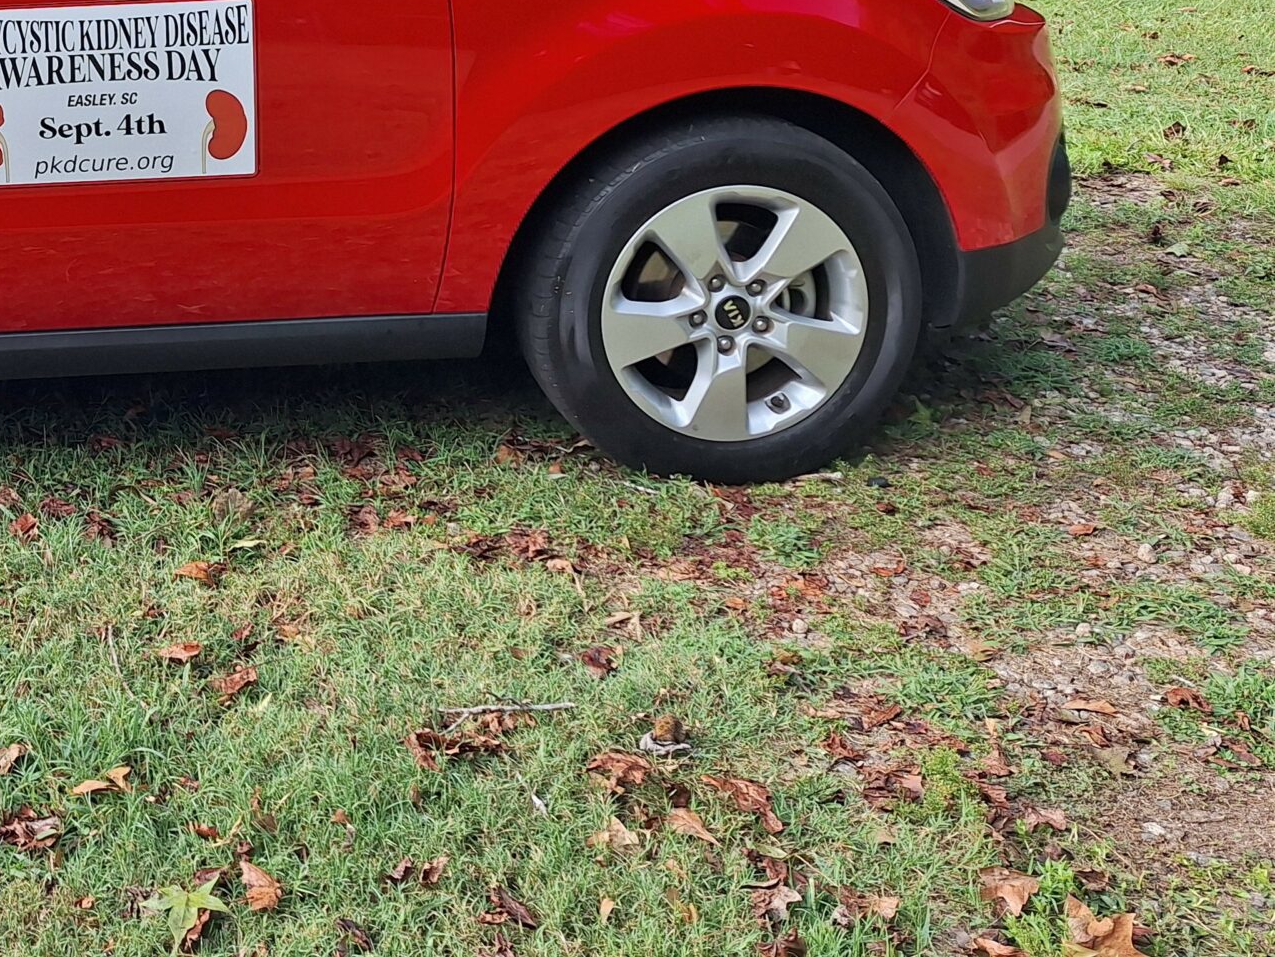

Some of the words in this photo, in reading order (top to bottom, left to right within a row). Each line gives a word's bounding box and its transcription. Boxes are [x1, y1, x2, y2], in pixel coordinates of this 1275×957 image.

[79, 16, 159, 51] KIDNEY
[165, 4, 249, 48] DISEASE
[167, 48, 222, 82] DAY
[120, 92, 138, 105] SC
[38, 116, 112, 145] Sept.
[116, 113, 167, 137] 4th
[34, 154, 174, 178] pkdcure.org
[723, 299, 745, 328] KIA
